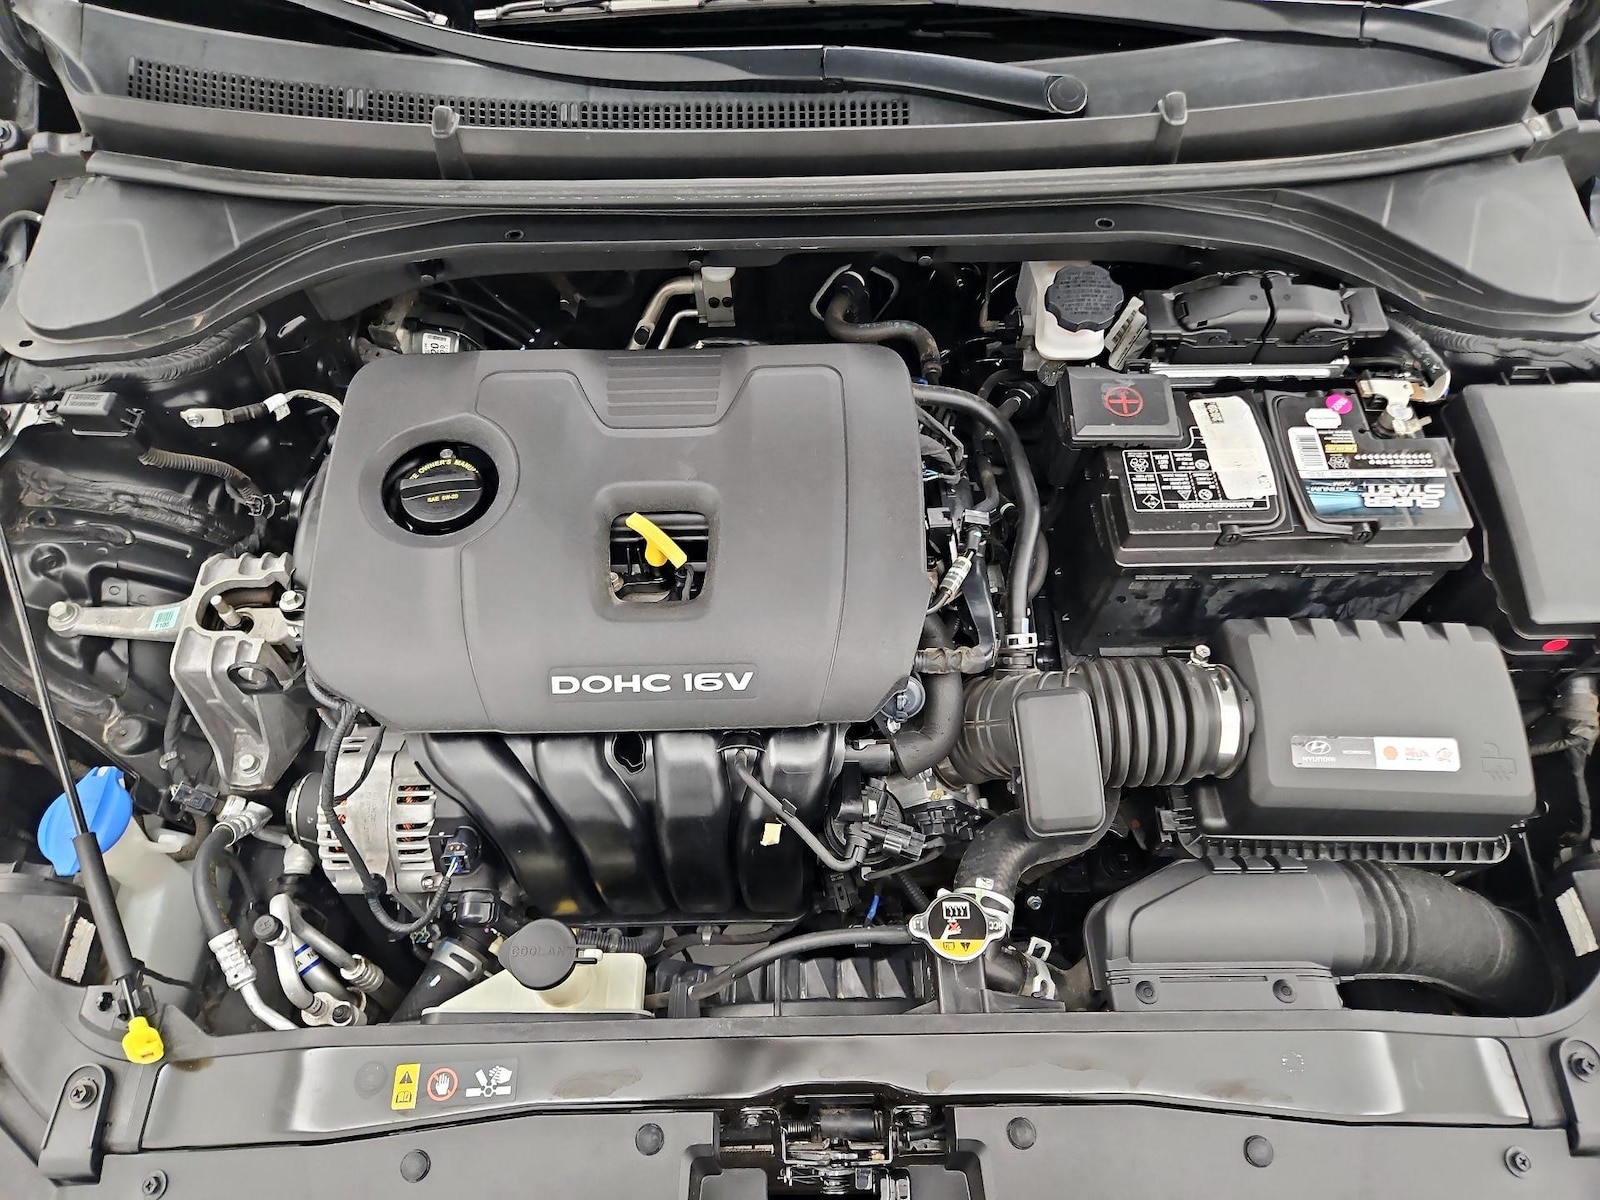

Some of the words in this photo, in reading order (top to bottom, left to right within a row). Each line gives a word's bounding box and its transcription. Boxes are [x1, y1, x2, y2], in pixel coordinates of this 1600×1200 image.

[418, 459, 452, 474] OWNER'S
[1361, 483, 1446, 498] START
[1363, 496, 1441, 508] SUPER
[551, 673, 672, 694] DOHC
[683, 671, 754, 692] 16V
[512, 945, 575, 958] COOLANT
